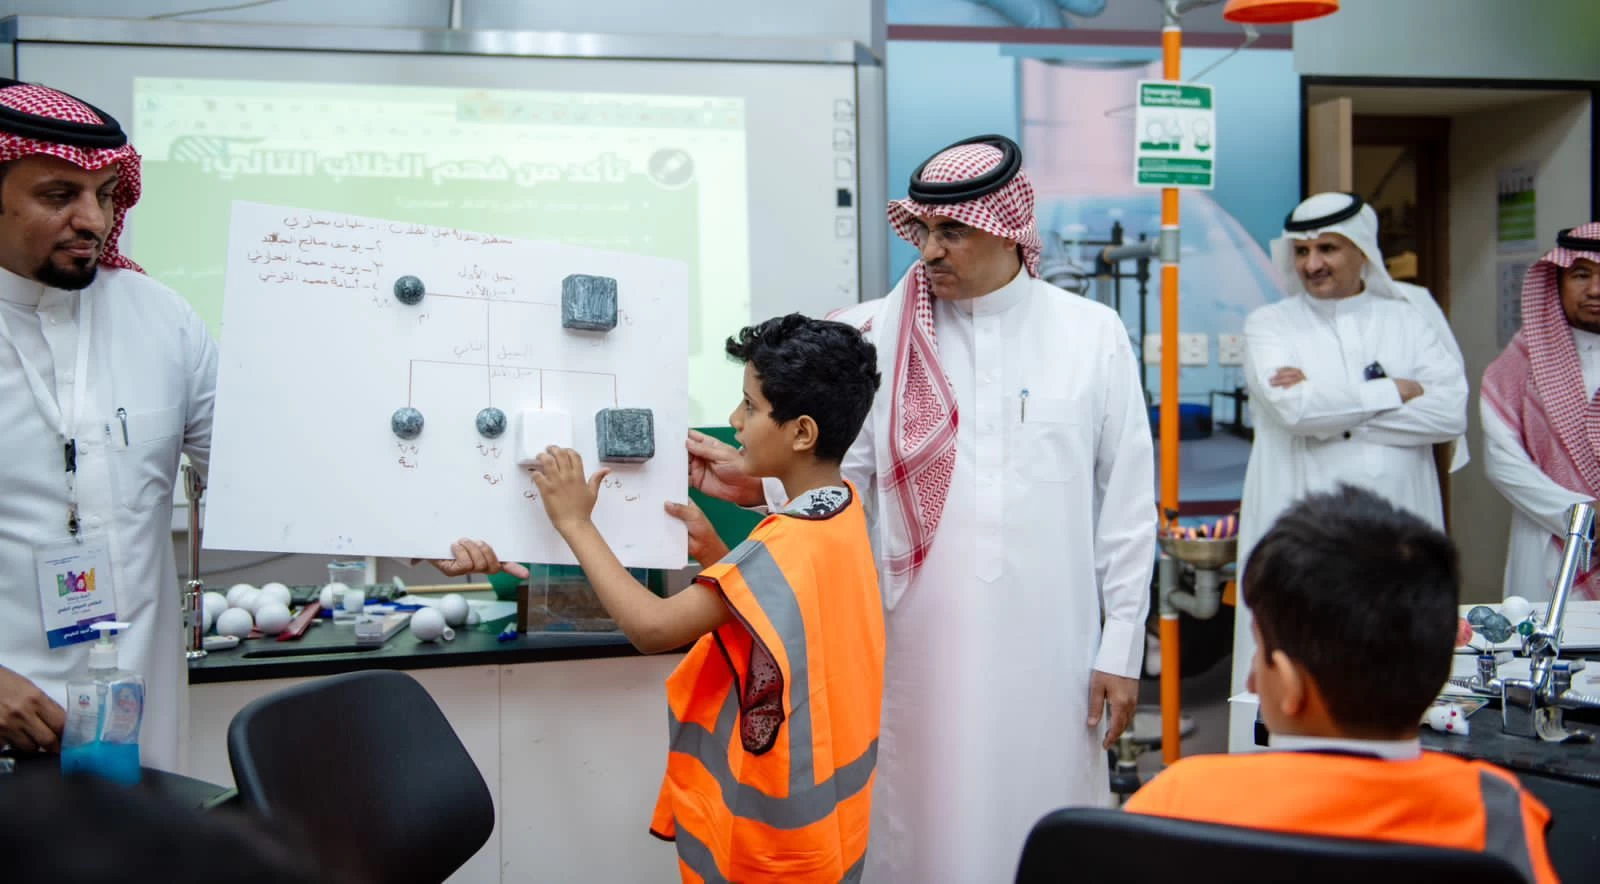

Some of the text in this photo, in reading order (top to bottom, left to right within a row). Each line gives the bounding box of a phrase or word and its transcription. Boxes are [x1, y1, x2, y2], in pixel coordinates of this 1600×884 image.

[322, 151, 426, 184] الطلاب
[431, 153, 510, 187] فهم
[515, 162, 562, 188] من
